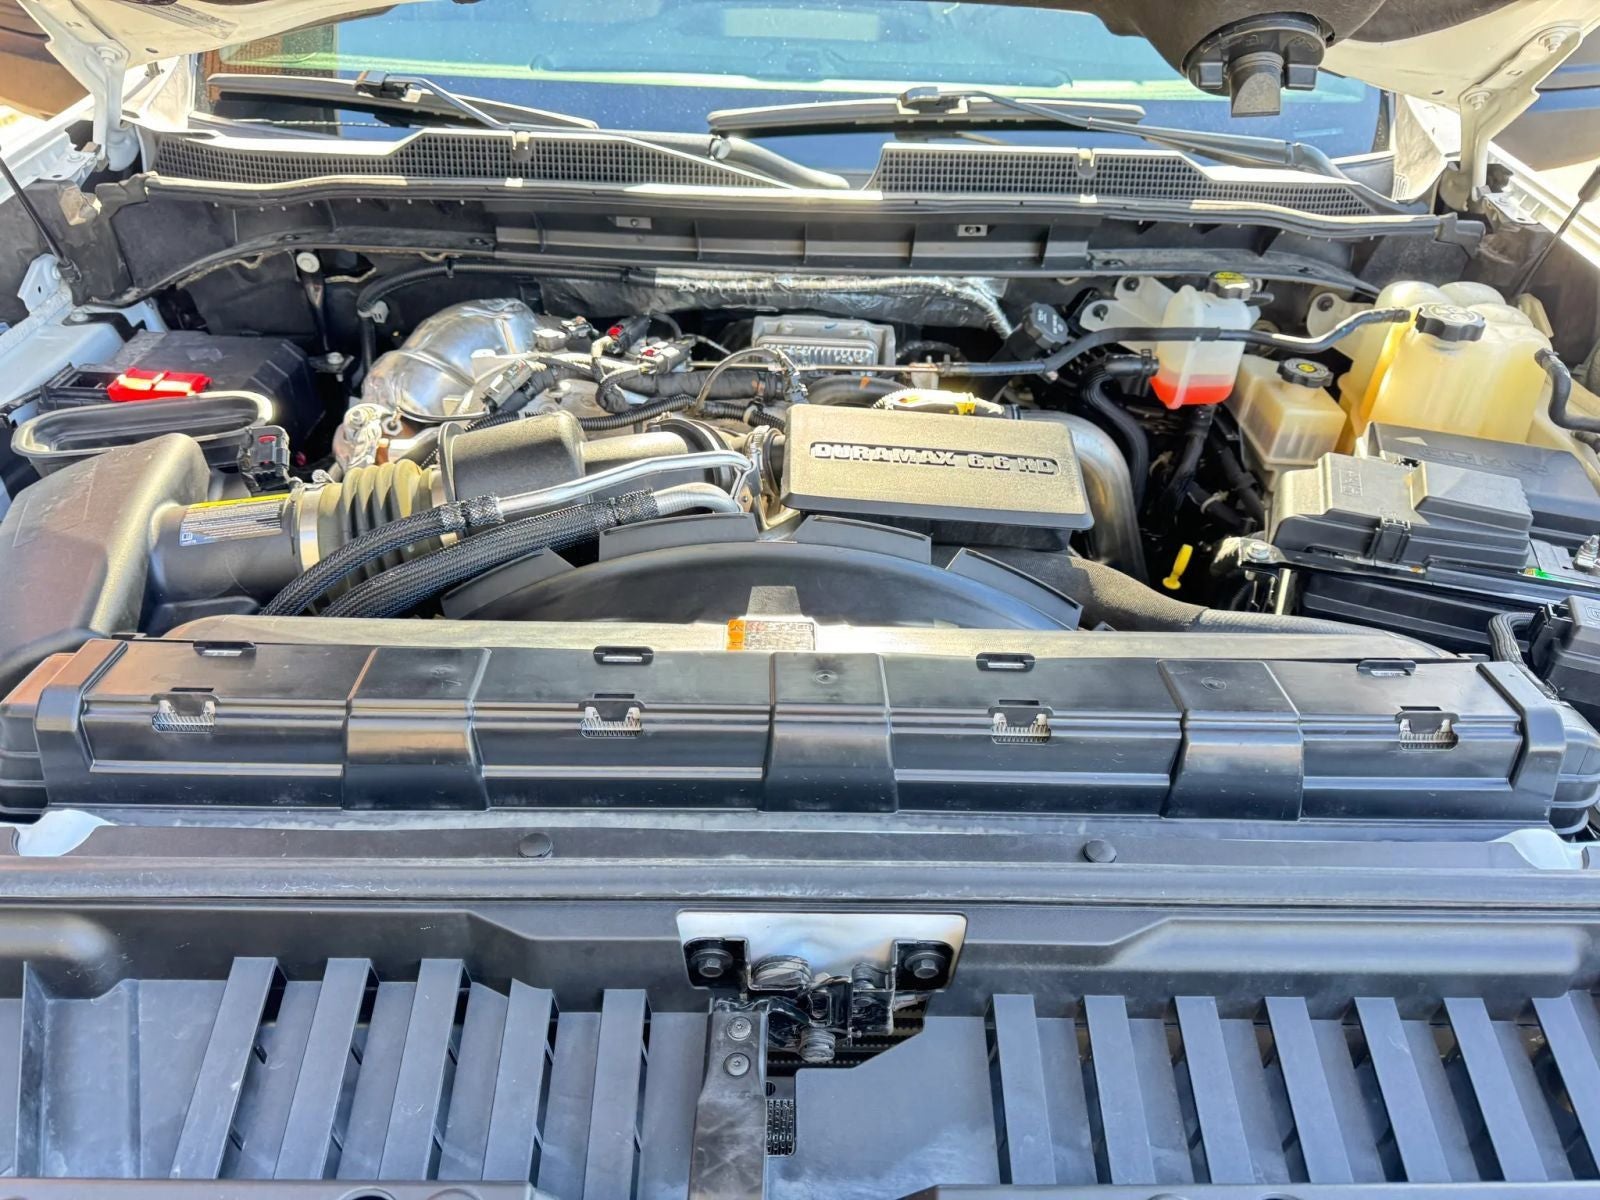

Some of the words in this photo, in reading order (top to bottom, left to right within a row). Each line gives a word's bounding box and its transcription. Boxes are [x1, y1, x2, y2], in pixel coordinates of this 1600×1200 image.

[812, 442, 955, 467] DURAMAX
[967, 453, 1010, 471] 6.6
[1017, 457, 1054, 475] HD
